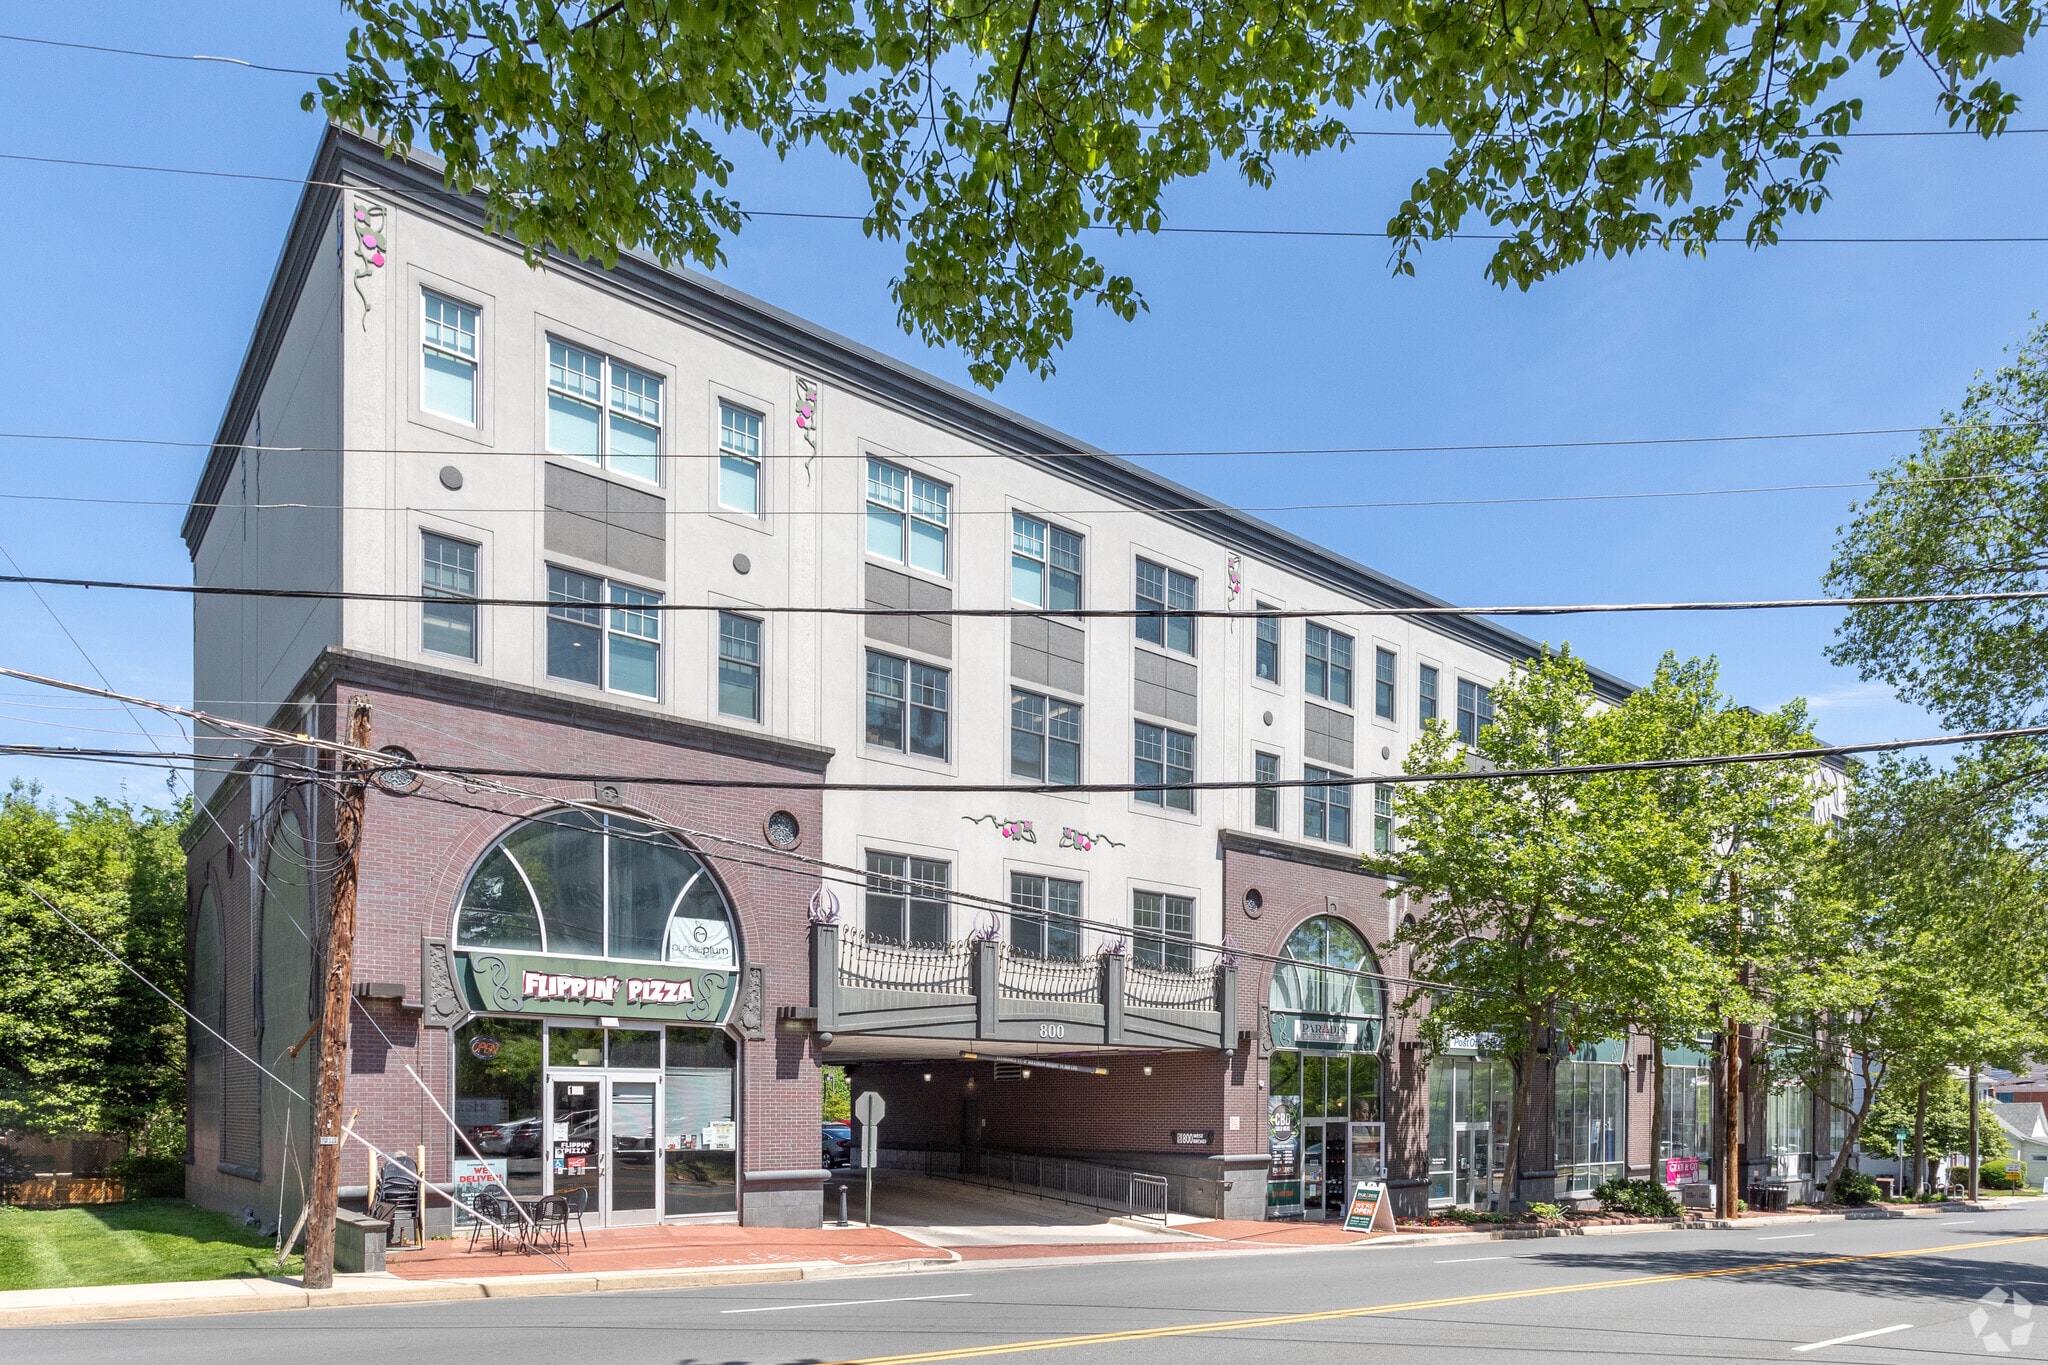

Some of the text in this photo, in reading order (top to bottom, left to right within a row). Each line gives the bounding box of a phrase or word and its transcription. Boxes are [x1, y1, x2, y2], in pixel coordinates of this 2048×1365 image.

[523, 971, 694, 1004] FLIPPIN' PIZZA
[1040, 1024, 1065, 1038] 800
[1302, 1023, 1351, 1035] PARADISE
[472, 1041, 499, 1054] OPEN
[1454, 1037, 1469, 1047] Post
[1275, 1113, 1290, 1126] CBD
[1183, 1133, 1194, 1144] 800
[1670, 1163, 1684, 1172] GRAB
[1690, 1162, 1698, 1170] GO
